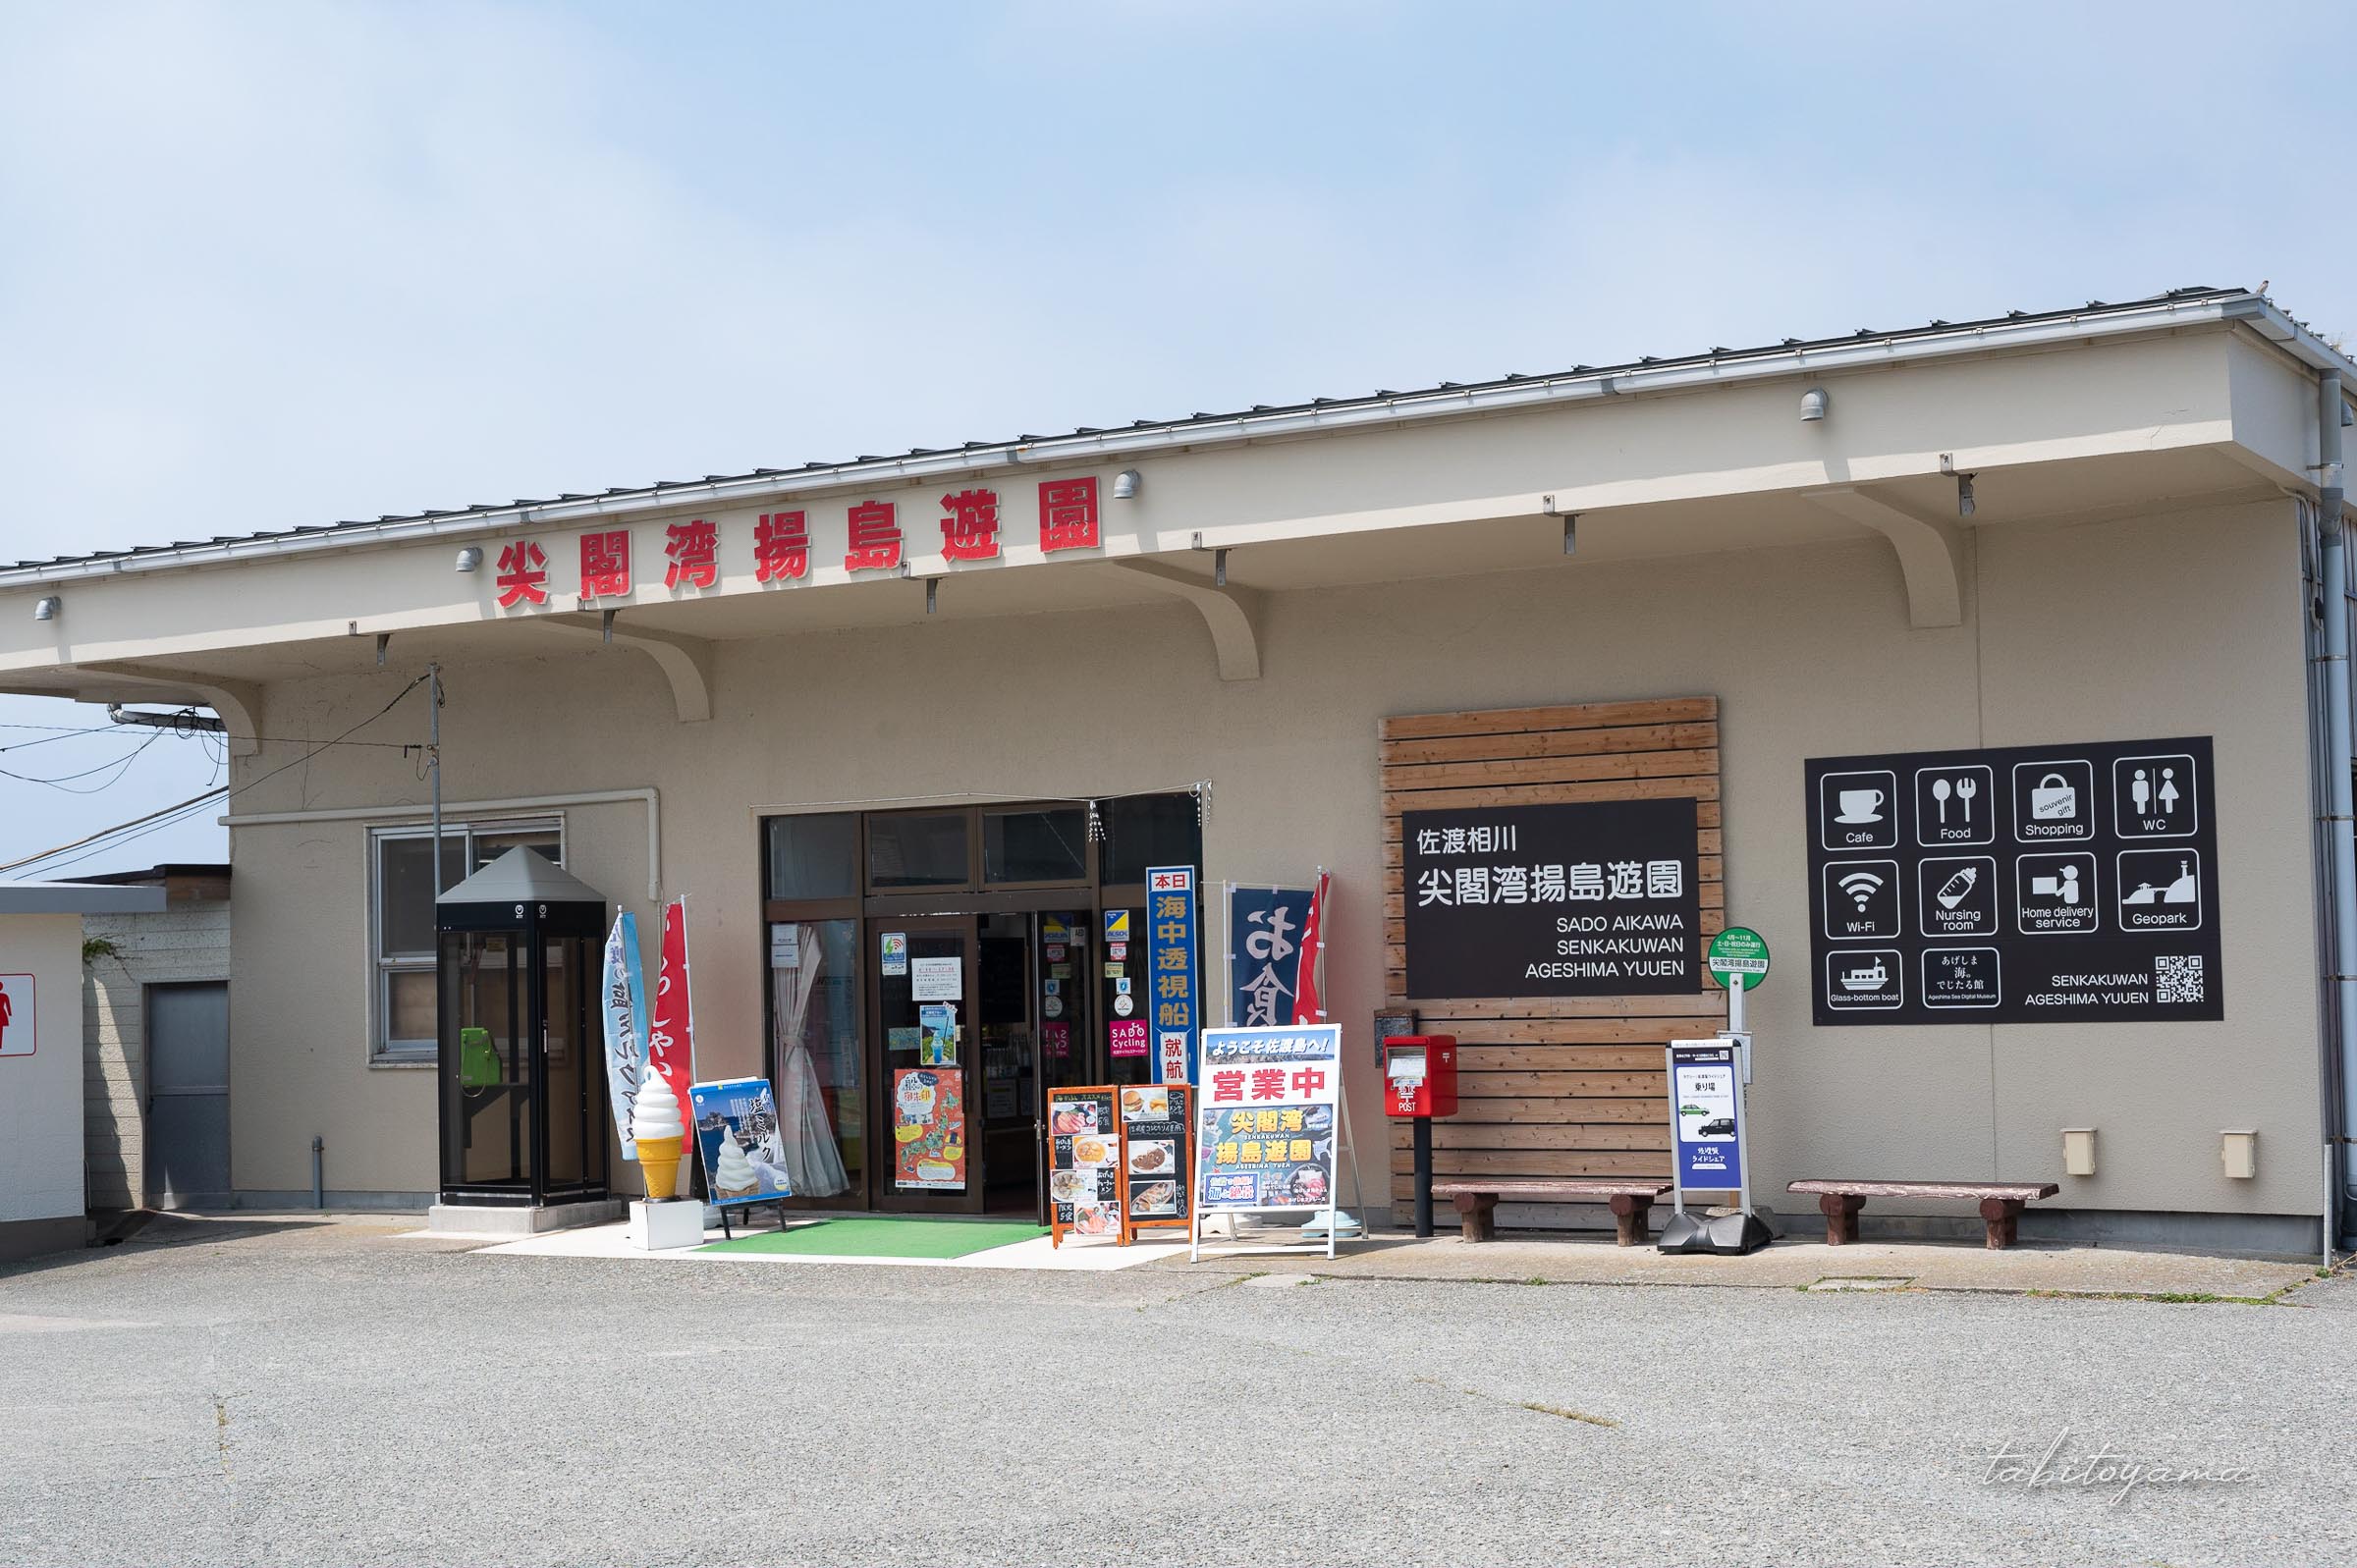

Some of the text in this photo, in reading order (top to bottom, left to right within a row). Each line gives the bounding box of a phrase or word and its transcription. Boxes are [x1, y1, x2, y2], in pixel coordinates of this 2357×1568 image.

[496, 476, 1100, 609] 尖閣湾揚島遊園
[2039, 794, 2073, 813] souvenir
[2057, 805, 2071, 817] gift
[2025, 824, 2084, 837] Shopping
[2143, 819, 2166, 831] WC
[1845, 832, 1874, 843] Cafe
[1940, 828, 1971, 838] Food
[1416, 825, 1516, 856] 佐渡相川
[1154, 874, 1186, 890] 本日
[1417, 859, 1683, 907] 尖閣湾揚島遊園
[1935, 909, 1981, 921] Nursing
[2021, 905, 2094, 919] Home delivery
[2132, 912, 2188, 925] Geopark
[1556, 914, 1684, 934] SADO AIKAWA
[1846, 922, 1876, 933] Wi-Fi
[1943, 920, 1974, 931] room
[2035, 917, 2081, 928] service
[1556, 938, 1684, 955] SENKAKUWAN
[1155, 894, 1189, 1027] 海中透視船
[1941, 954, 1978, 966] あげしま
[1524, 960, 1684, 979] AGESHIMA YUUEN
[1936, 979, 1985, 991] でじたる館
[2051, 973, 2149, 987] SENKAKUWAN
[1830, 993, 1899, 1002] Glass-bottom boat
[2024, 993, 2150, 1005] AGESHIMA YUUEN
[1112, 1027, 1145, 1038] SADO
[1112, 1038, 1146, 1050] Cycling
[1164, 1038, 1183, 1079] 就航
[1212, 1066, 1326, 1103] 営業中
[1398, 1102, 1416, 1112] POST
[1231, 1108, 1304, 1134] 尖閣湾
[749, 1096, 772, 1162] 塩ミルク
[1215, 1139, 1313, 1165] 揚島遊園
